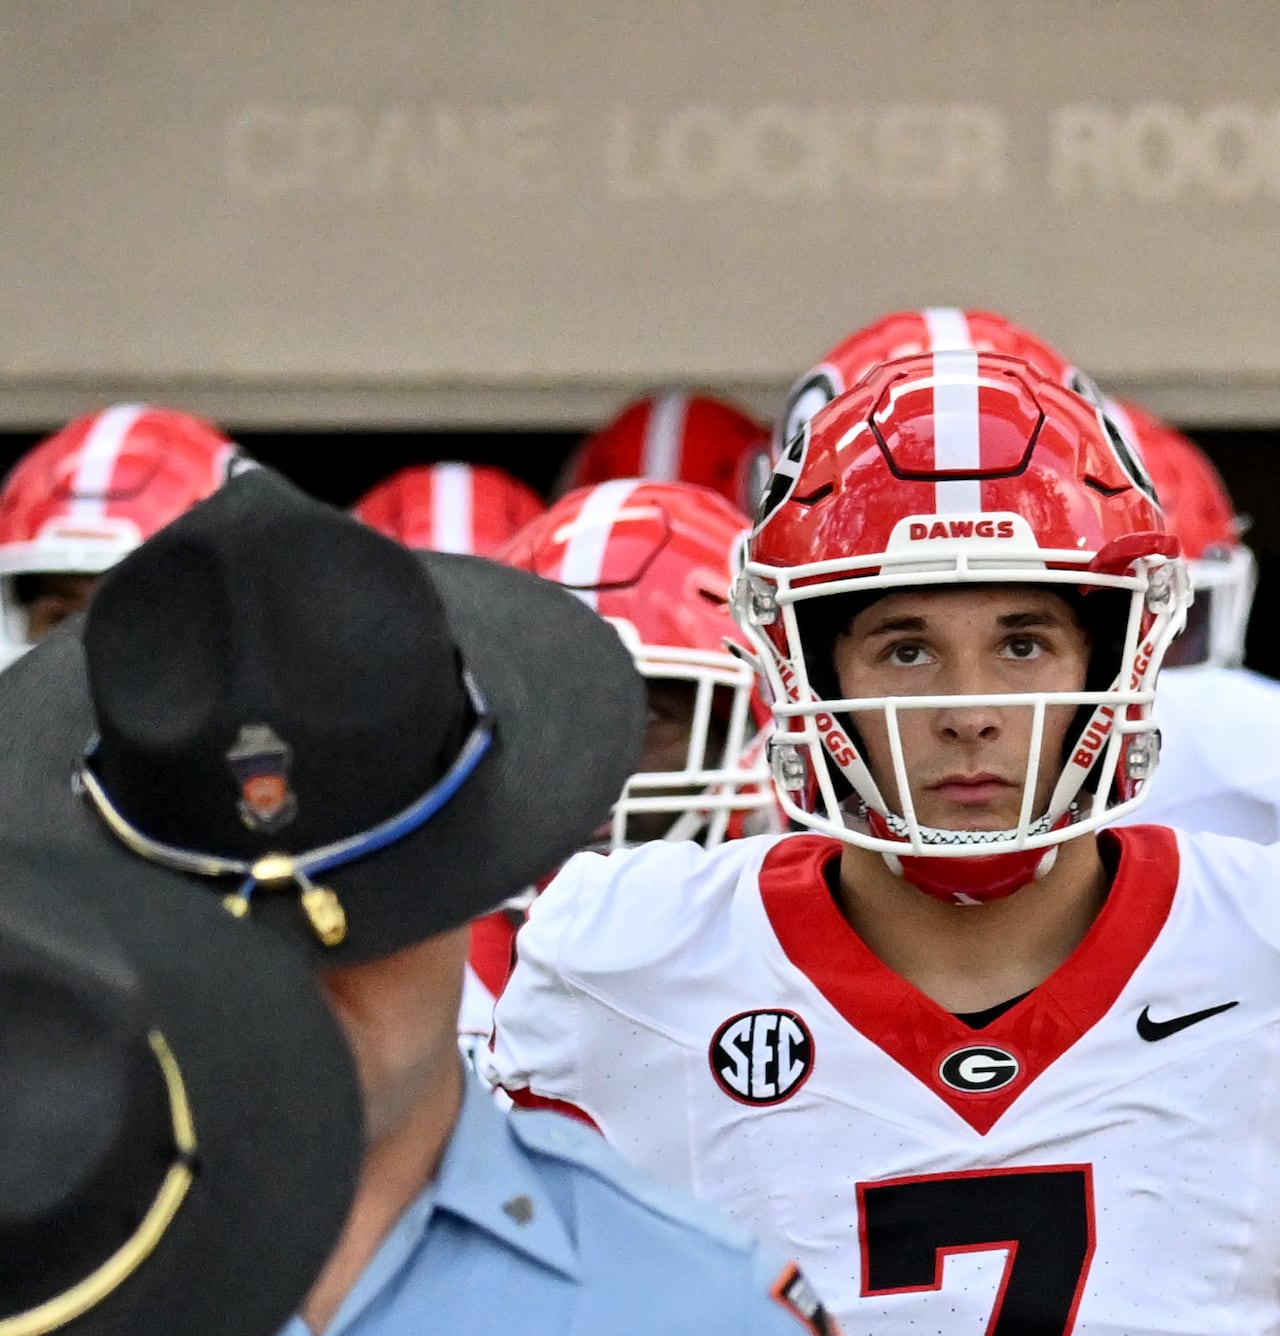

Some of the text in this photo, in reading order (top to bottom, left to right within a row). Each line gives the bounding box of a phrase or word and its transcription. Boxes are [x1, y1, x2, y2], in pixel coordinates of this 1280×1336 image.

[224, 104, 566, 196] CRANE
[604, 104, 1009, 196] LOCKER
[909, 521, 1014, 541] DAWGS
[718, 1012, 806, 1098] SEC
[938, 1046, 1019, 1093] G
